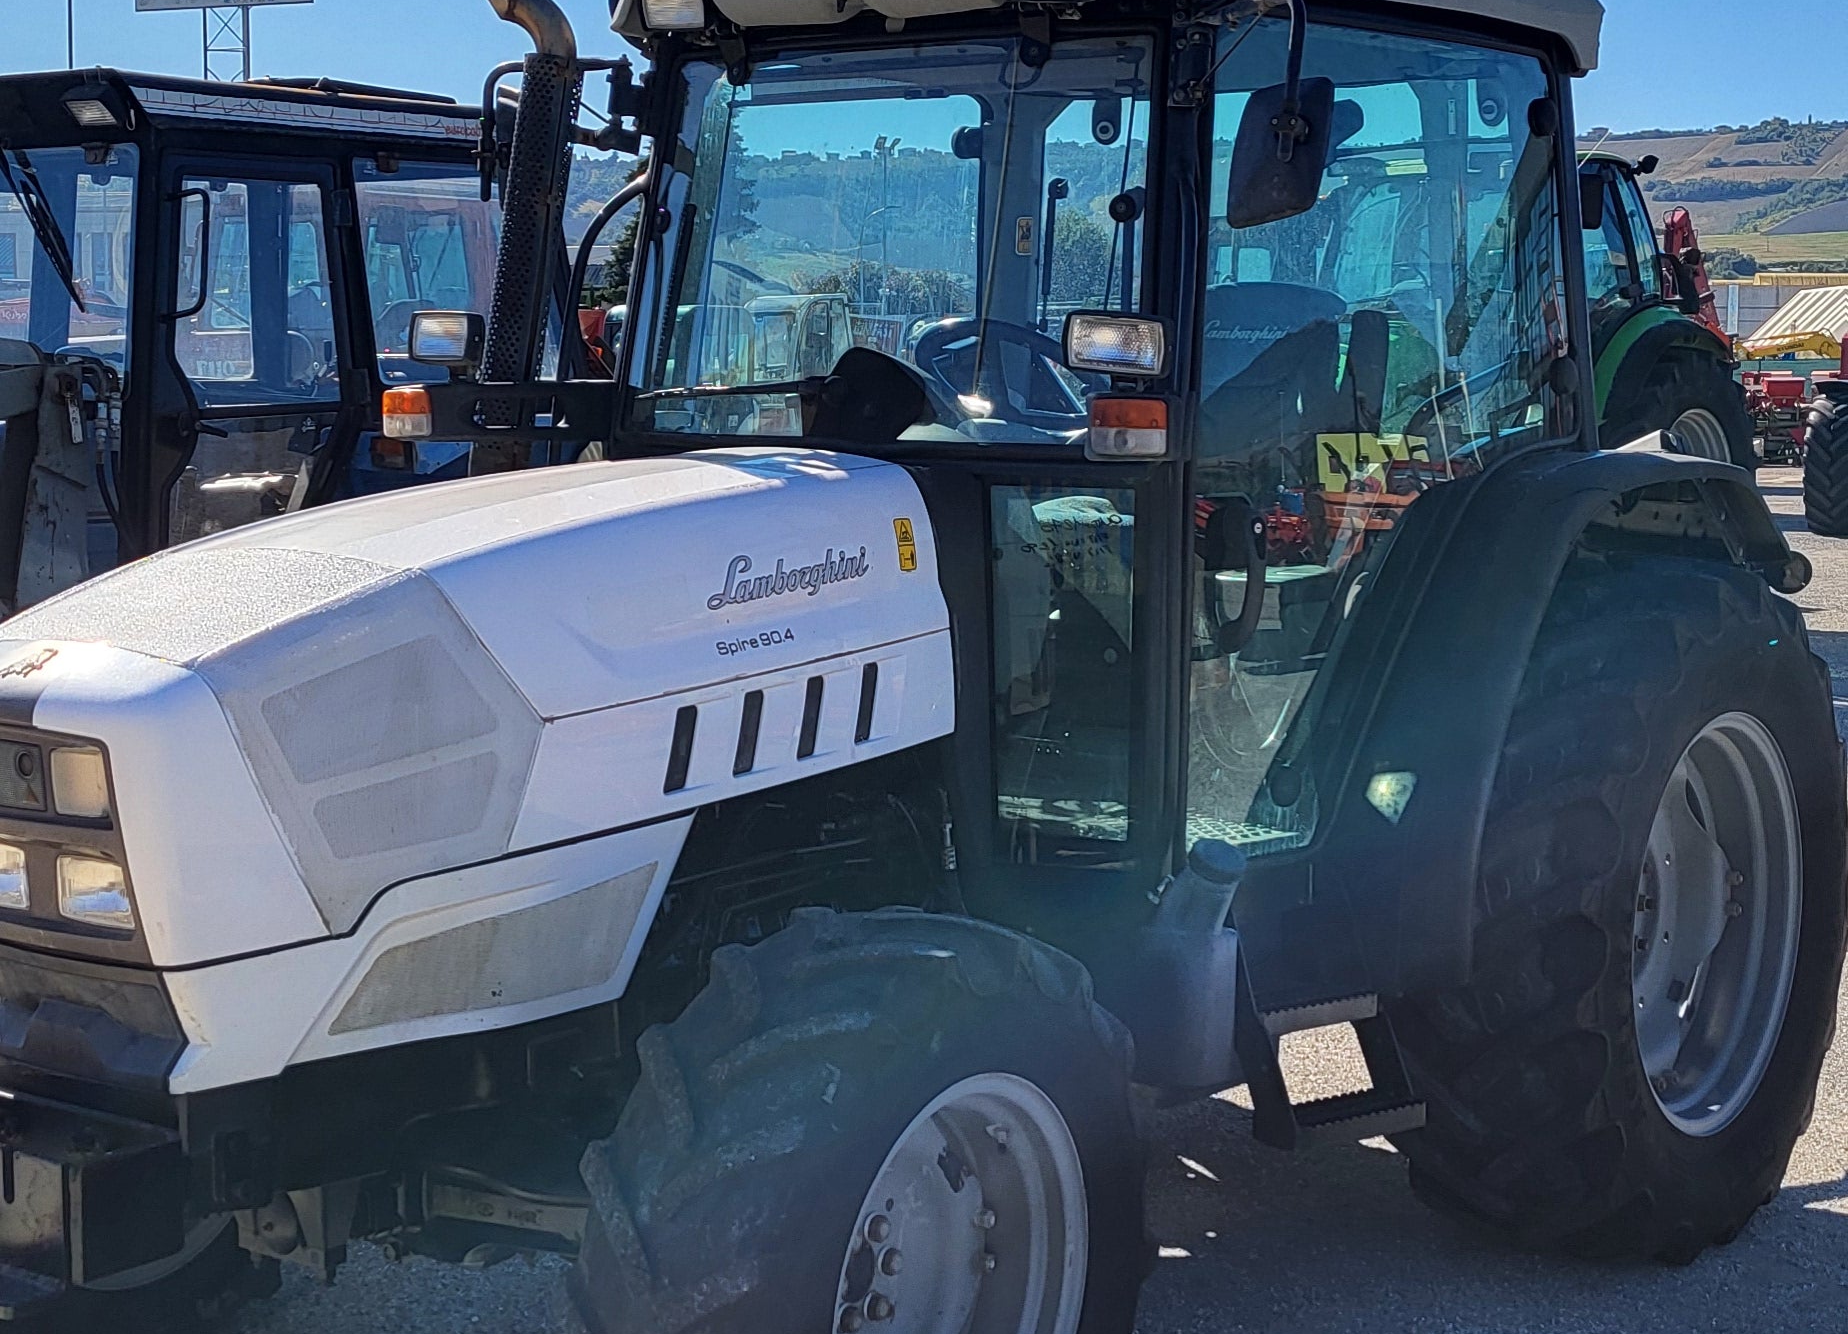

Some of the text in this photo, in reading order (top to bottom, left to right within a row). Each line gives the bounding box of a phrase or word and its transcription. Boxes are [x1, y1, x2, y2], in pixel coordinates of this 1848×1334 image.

[1204, 319, 1290, 344] Lamborghini
[707, 545, 869, 610] Lamborghini
[716, 628, 794, 656] Spire 90.4
